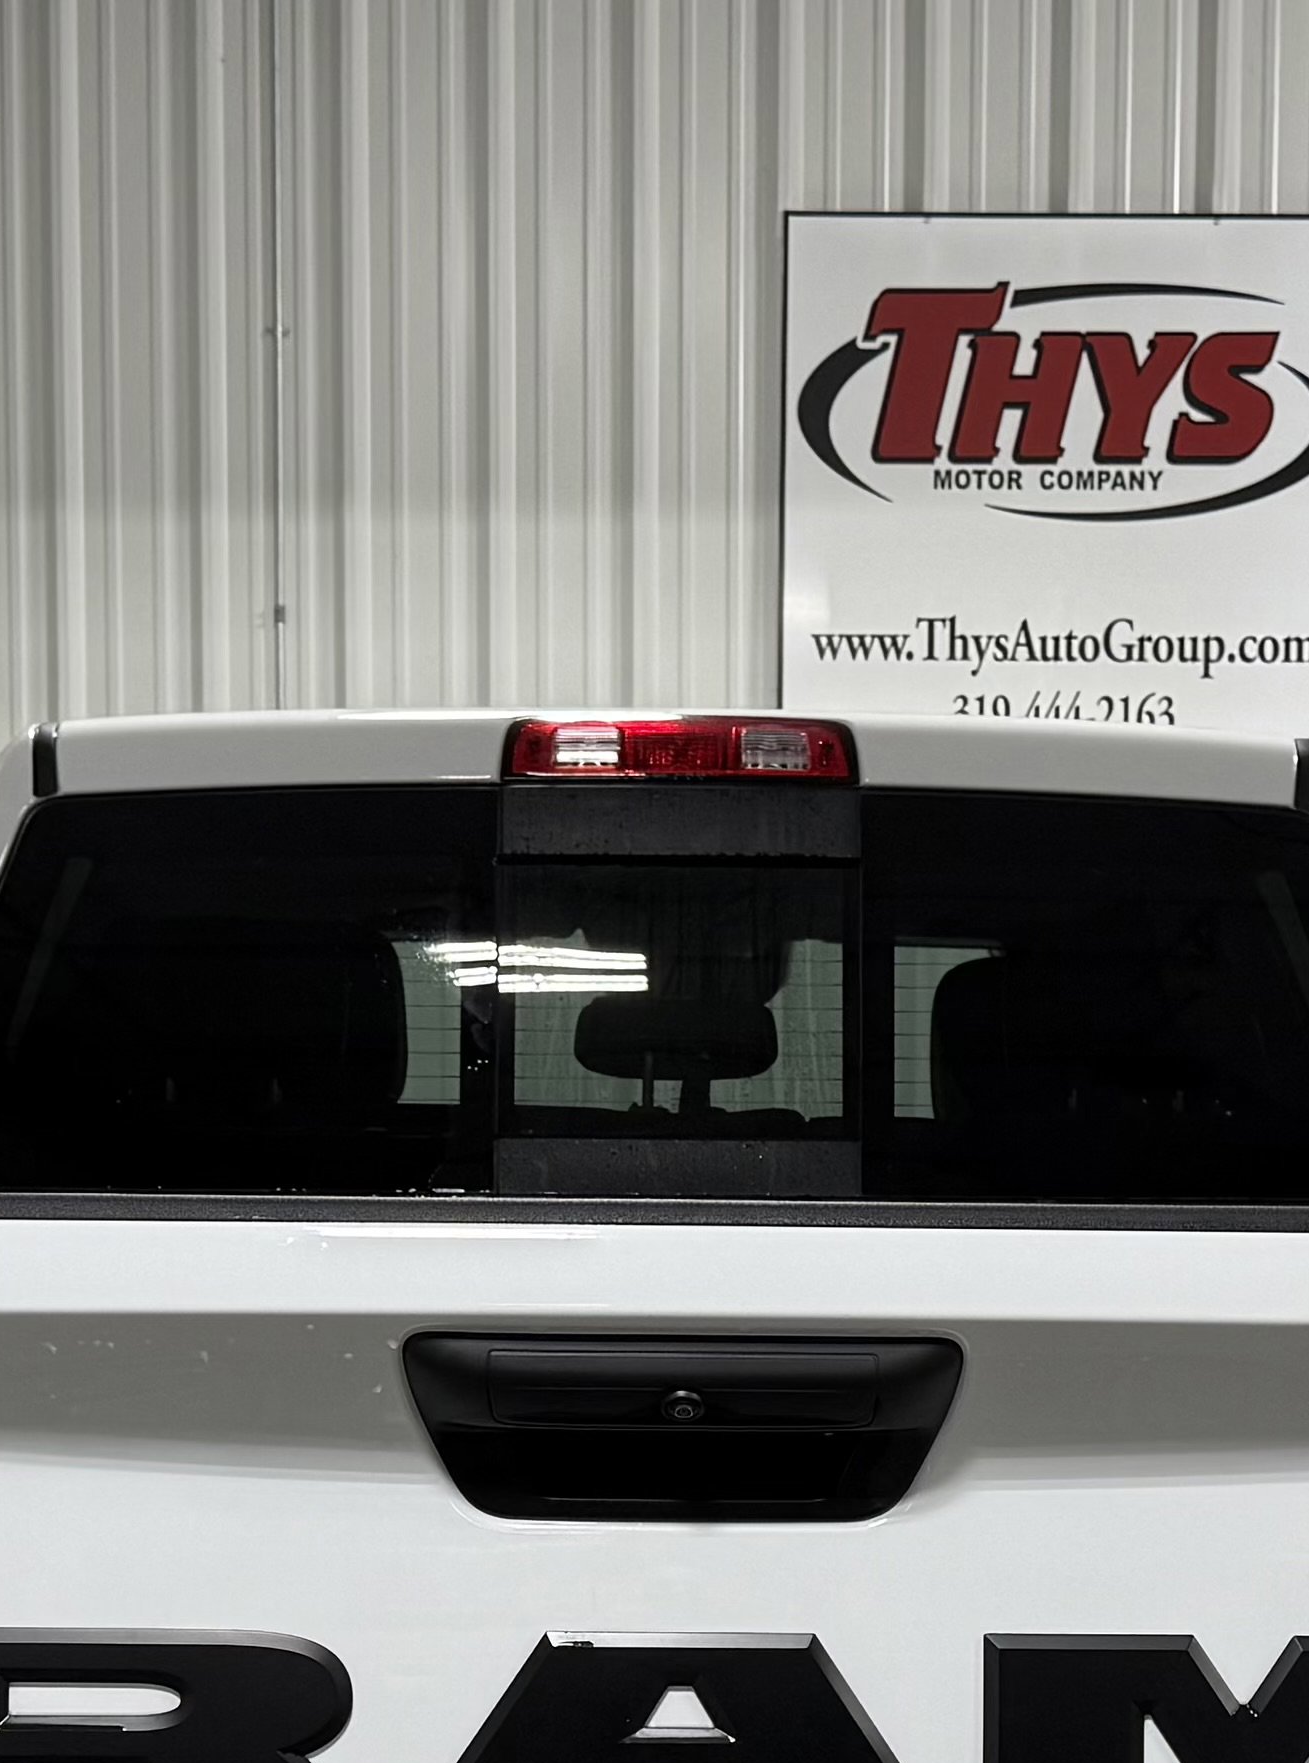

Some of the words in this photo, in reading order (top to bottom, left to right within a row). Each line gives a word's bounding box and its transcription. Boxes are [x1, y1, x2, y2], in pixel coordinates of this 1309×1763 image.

[862, 281, 1281, 465] THYS
[932, 469, 1023, 491] MOTOR
[1039, 469, 1164, 492] COMPANY
